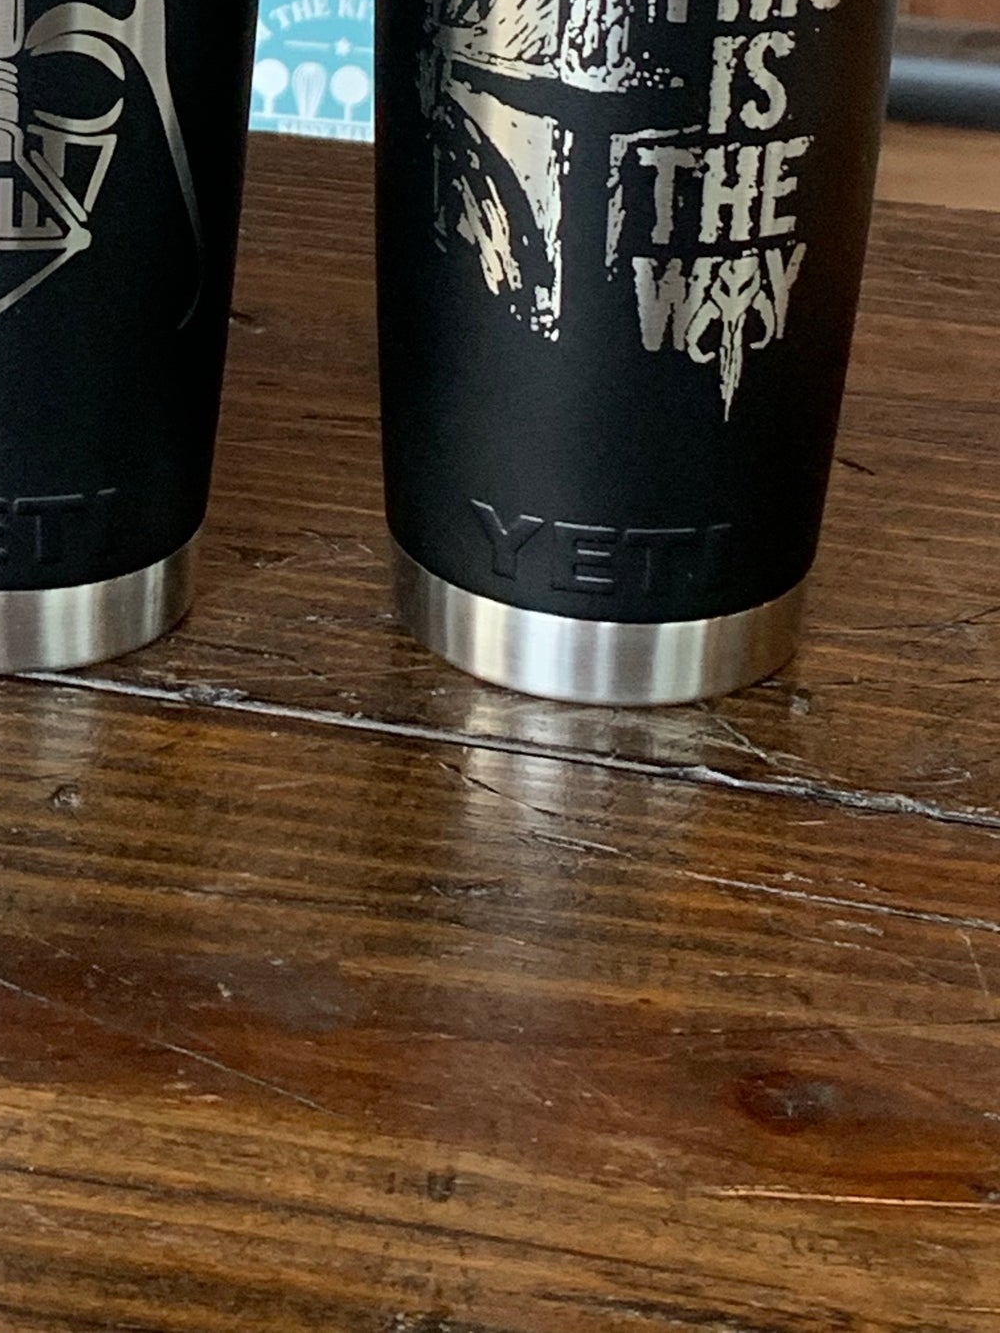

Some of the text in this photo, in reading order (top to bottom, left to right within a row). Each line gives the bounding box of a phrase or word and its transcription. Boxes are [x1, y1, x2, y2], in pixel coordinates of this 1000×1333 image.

[708, 31, 796, 134] IS
[636, 136, 816, 246] THE
[469, 498, 735, 598] YETI
